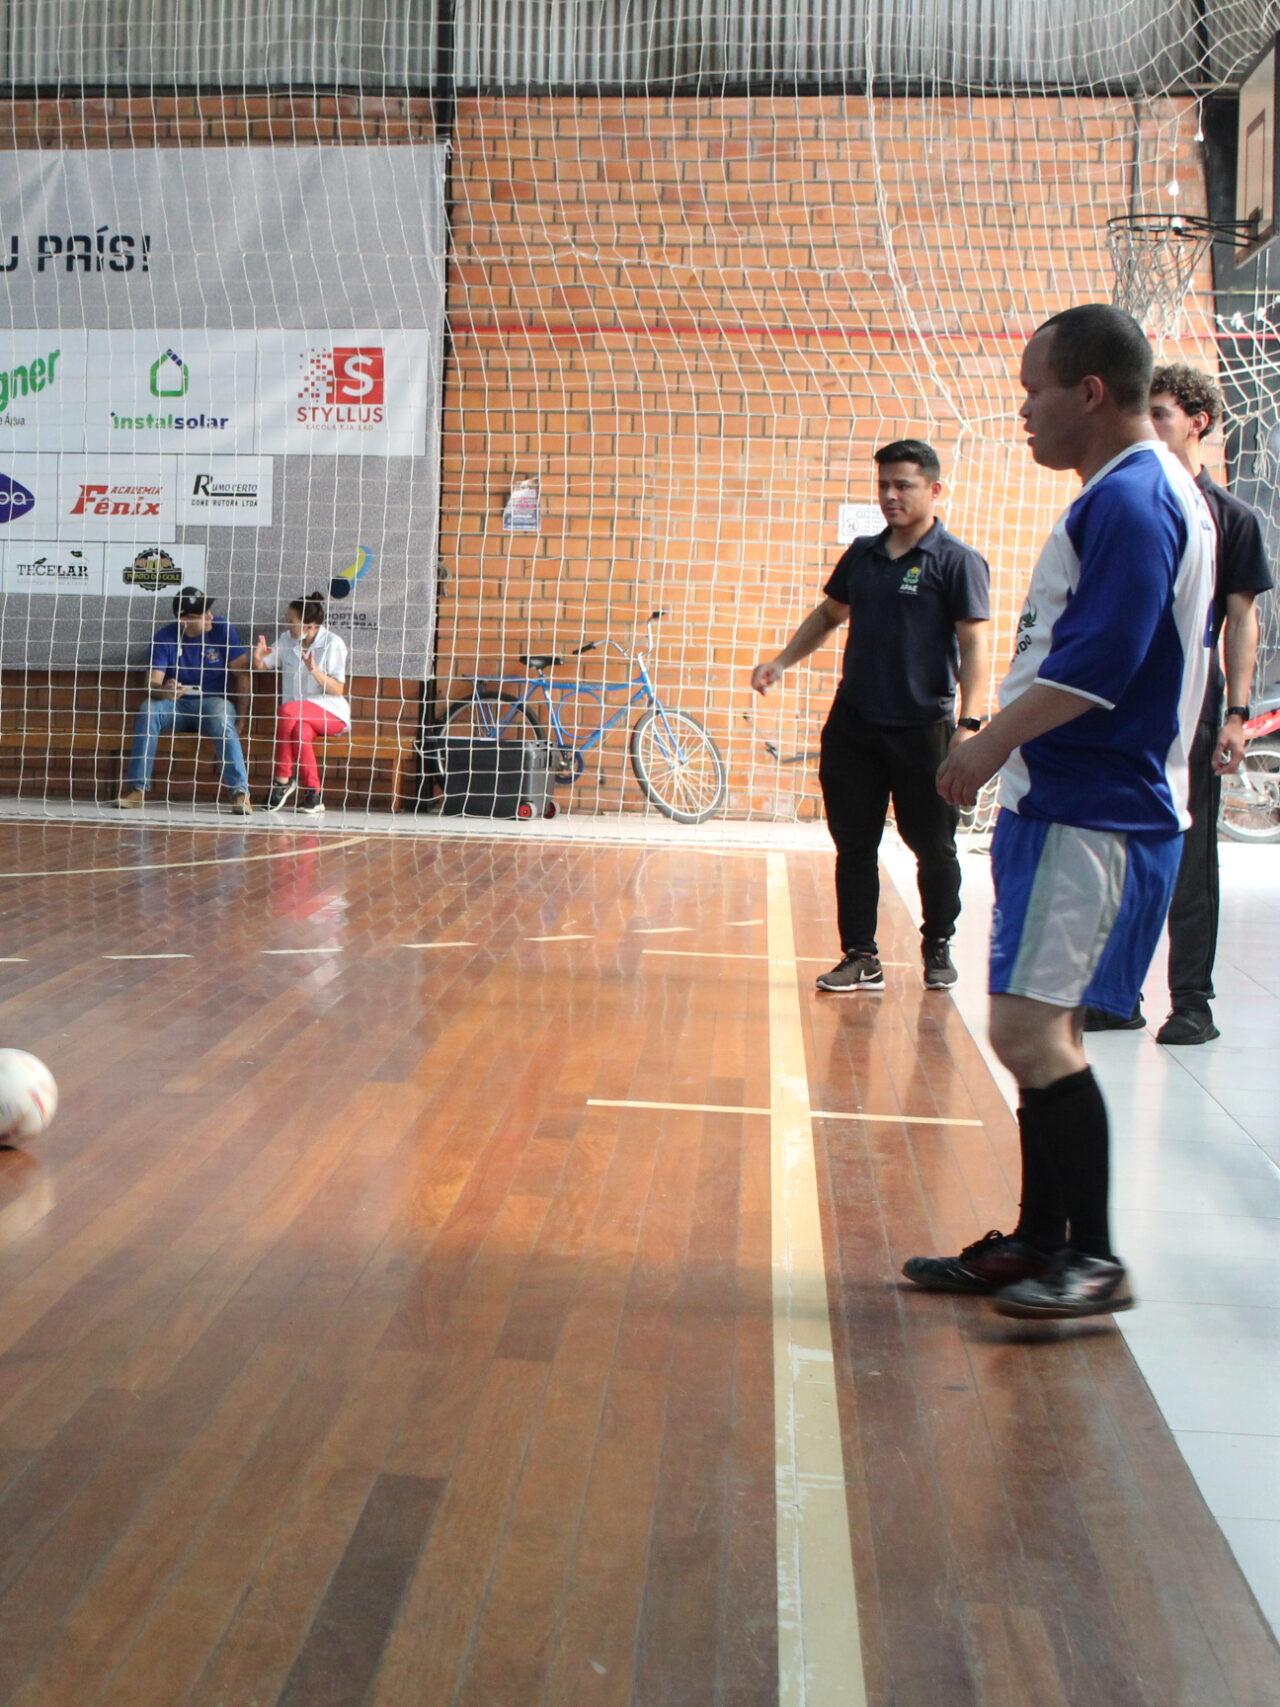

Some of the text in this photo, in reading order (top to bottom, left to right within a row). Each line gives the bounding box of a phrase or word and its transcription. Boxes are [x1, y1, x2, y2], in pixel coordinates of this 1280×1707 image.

[38, 225, 151, 272] PAÍS!
[111, 412, 229, 430] instalsolar
[297, 407, 384, 423] STYLLUS
[70, 485, 162, 515] Fênix
[17, 564, 89, 577] TECELAR
